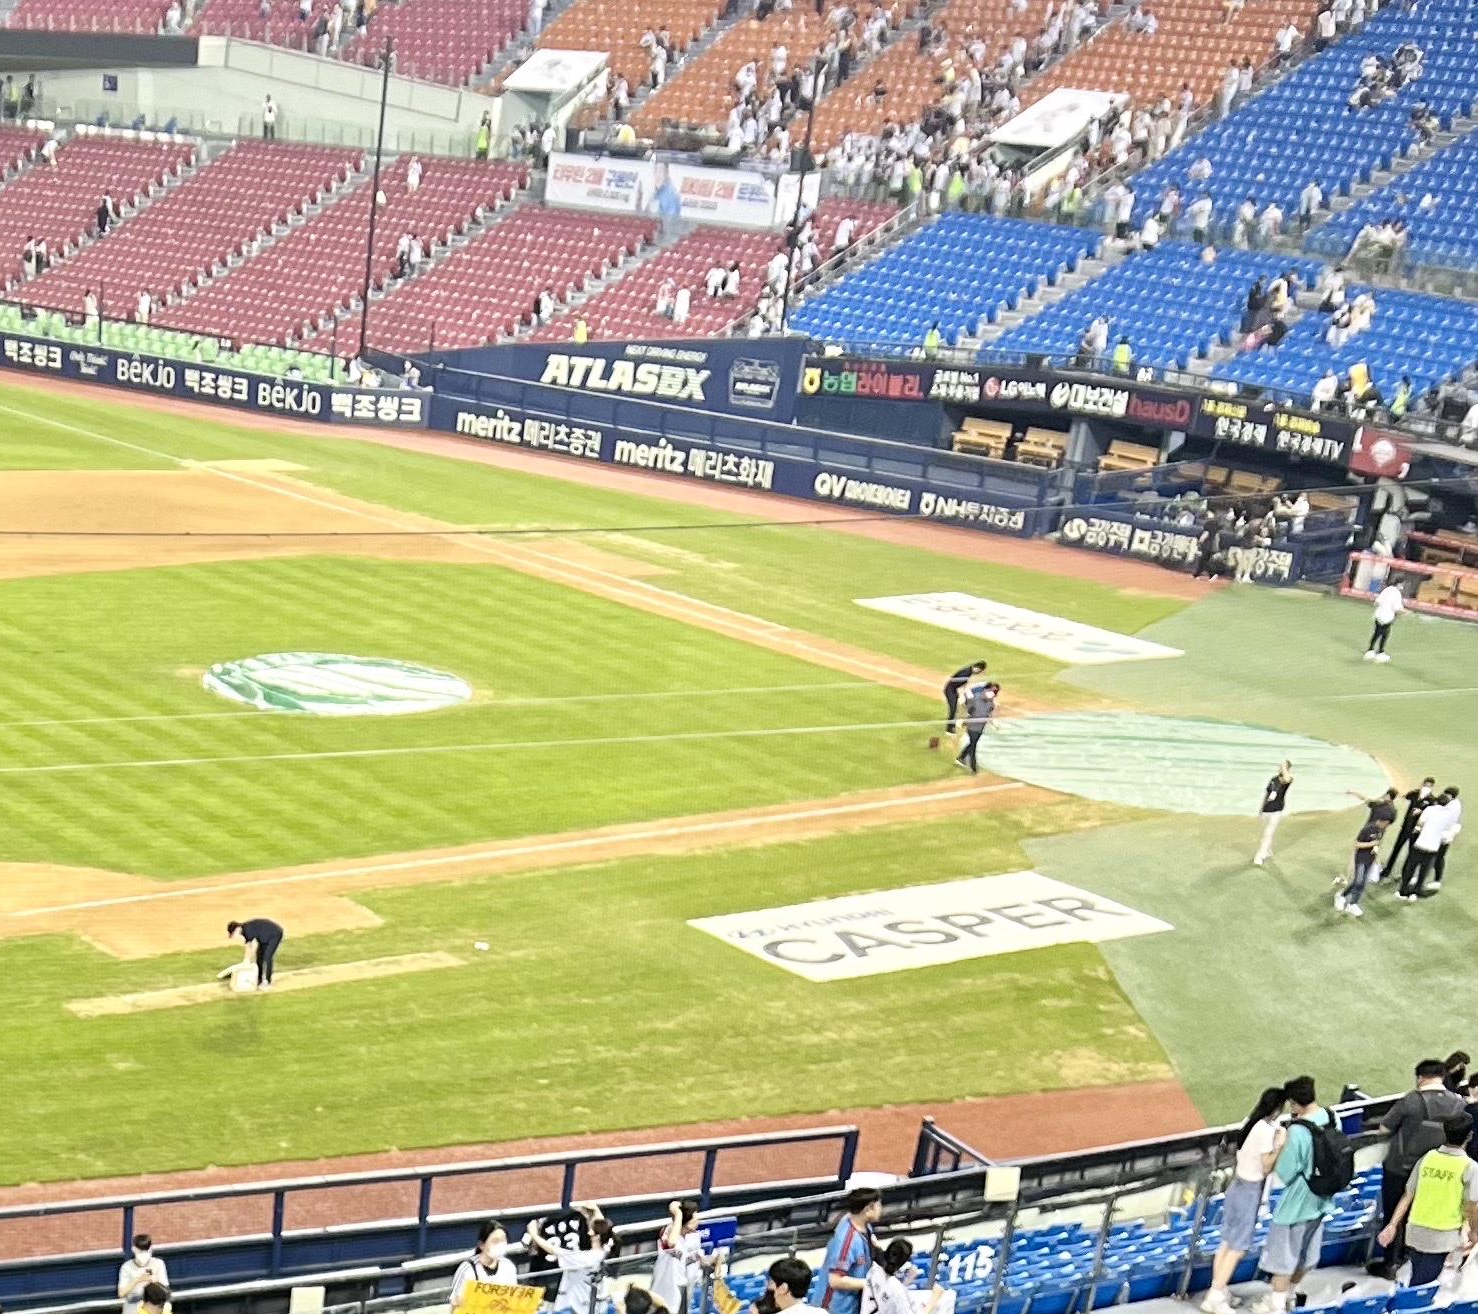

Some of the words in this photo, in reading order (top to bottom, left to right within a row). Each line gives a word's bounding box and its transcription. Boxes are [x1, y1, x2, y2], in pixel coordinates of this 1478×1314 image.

[4, 339, 62, 368] 백조씽크
[184, 368, 249, 401] 백조씽크
[540, 354, 712, 400] ATLASBX
[331, 392, 422, 422] 백조씽크
[1068, 383, 1129, 417] 대보건설
[456, 409, 521, 443] meritz
[523, 419, 602, 458] 메리츠증권
[1214, 416, 1268, 446] 한국경제
[1276, 430, 1344, 461] 한국경제TV
[614, 437, 686, 473] meritz
[687, 449, 775, 489] 메리츠화재
[814, 472, 847, 498] QV
[935, 496, 1025, 530] NH투자증권
[1084, 517, 1132, 550] 금강주택
[762, 896, 1131, 966] CASPER
[1422, 1166, 1455, 1182] STAFF
[949, 1245, 995, 1284] 115
